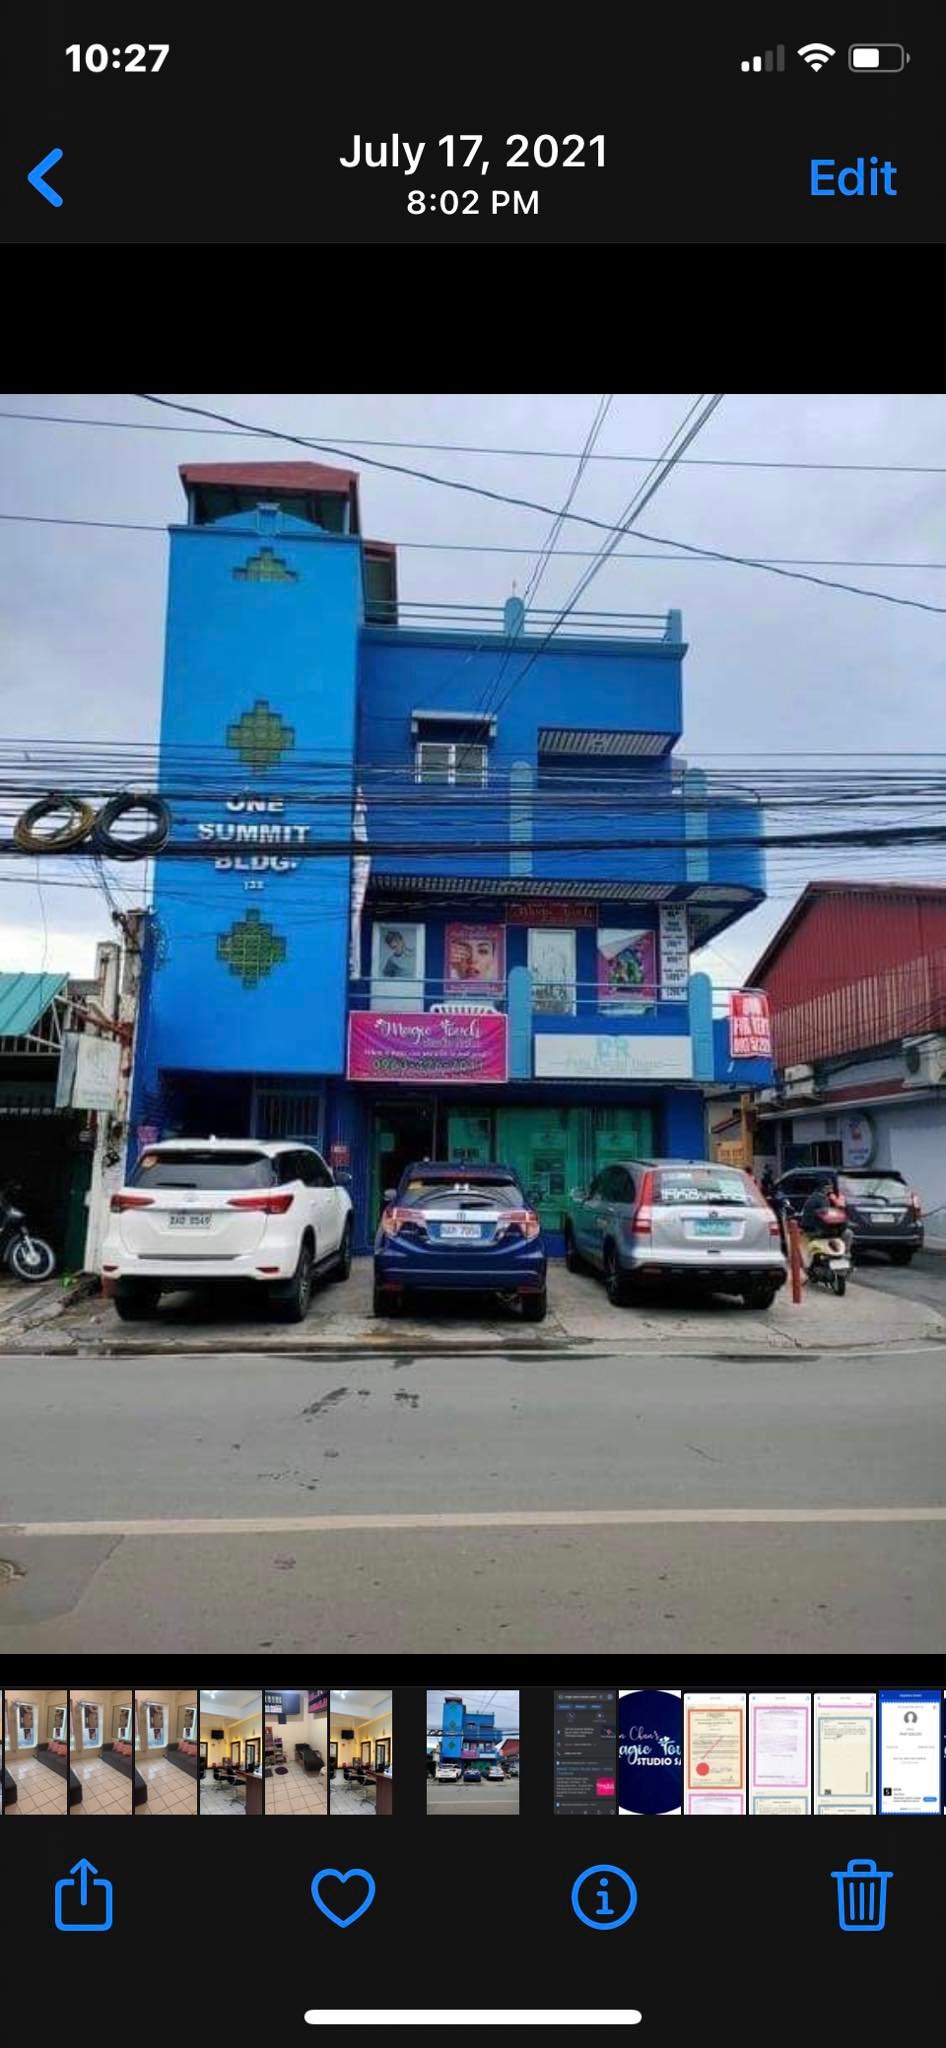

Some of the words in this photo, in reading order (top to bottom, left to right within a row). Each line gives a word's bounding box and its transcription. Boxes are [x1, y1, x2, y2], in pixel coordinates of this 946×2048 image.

[66, 44, 169, 72] 10:27
[340, 133, 426, 175] July
[439, 134, 489, 175] 17,
[507, 134, 605, 167] 2021
[811, 156, 897, 196] Edit
[407, 190, 479, 215] 8:02
[492, 190, 538, 214] PM
[226, 795, 285, 812] ONE
[198, 823, 310, 843] SUMMIT
[637, 1757, 672, 1765] STUDIO
